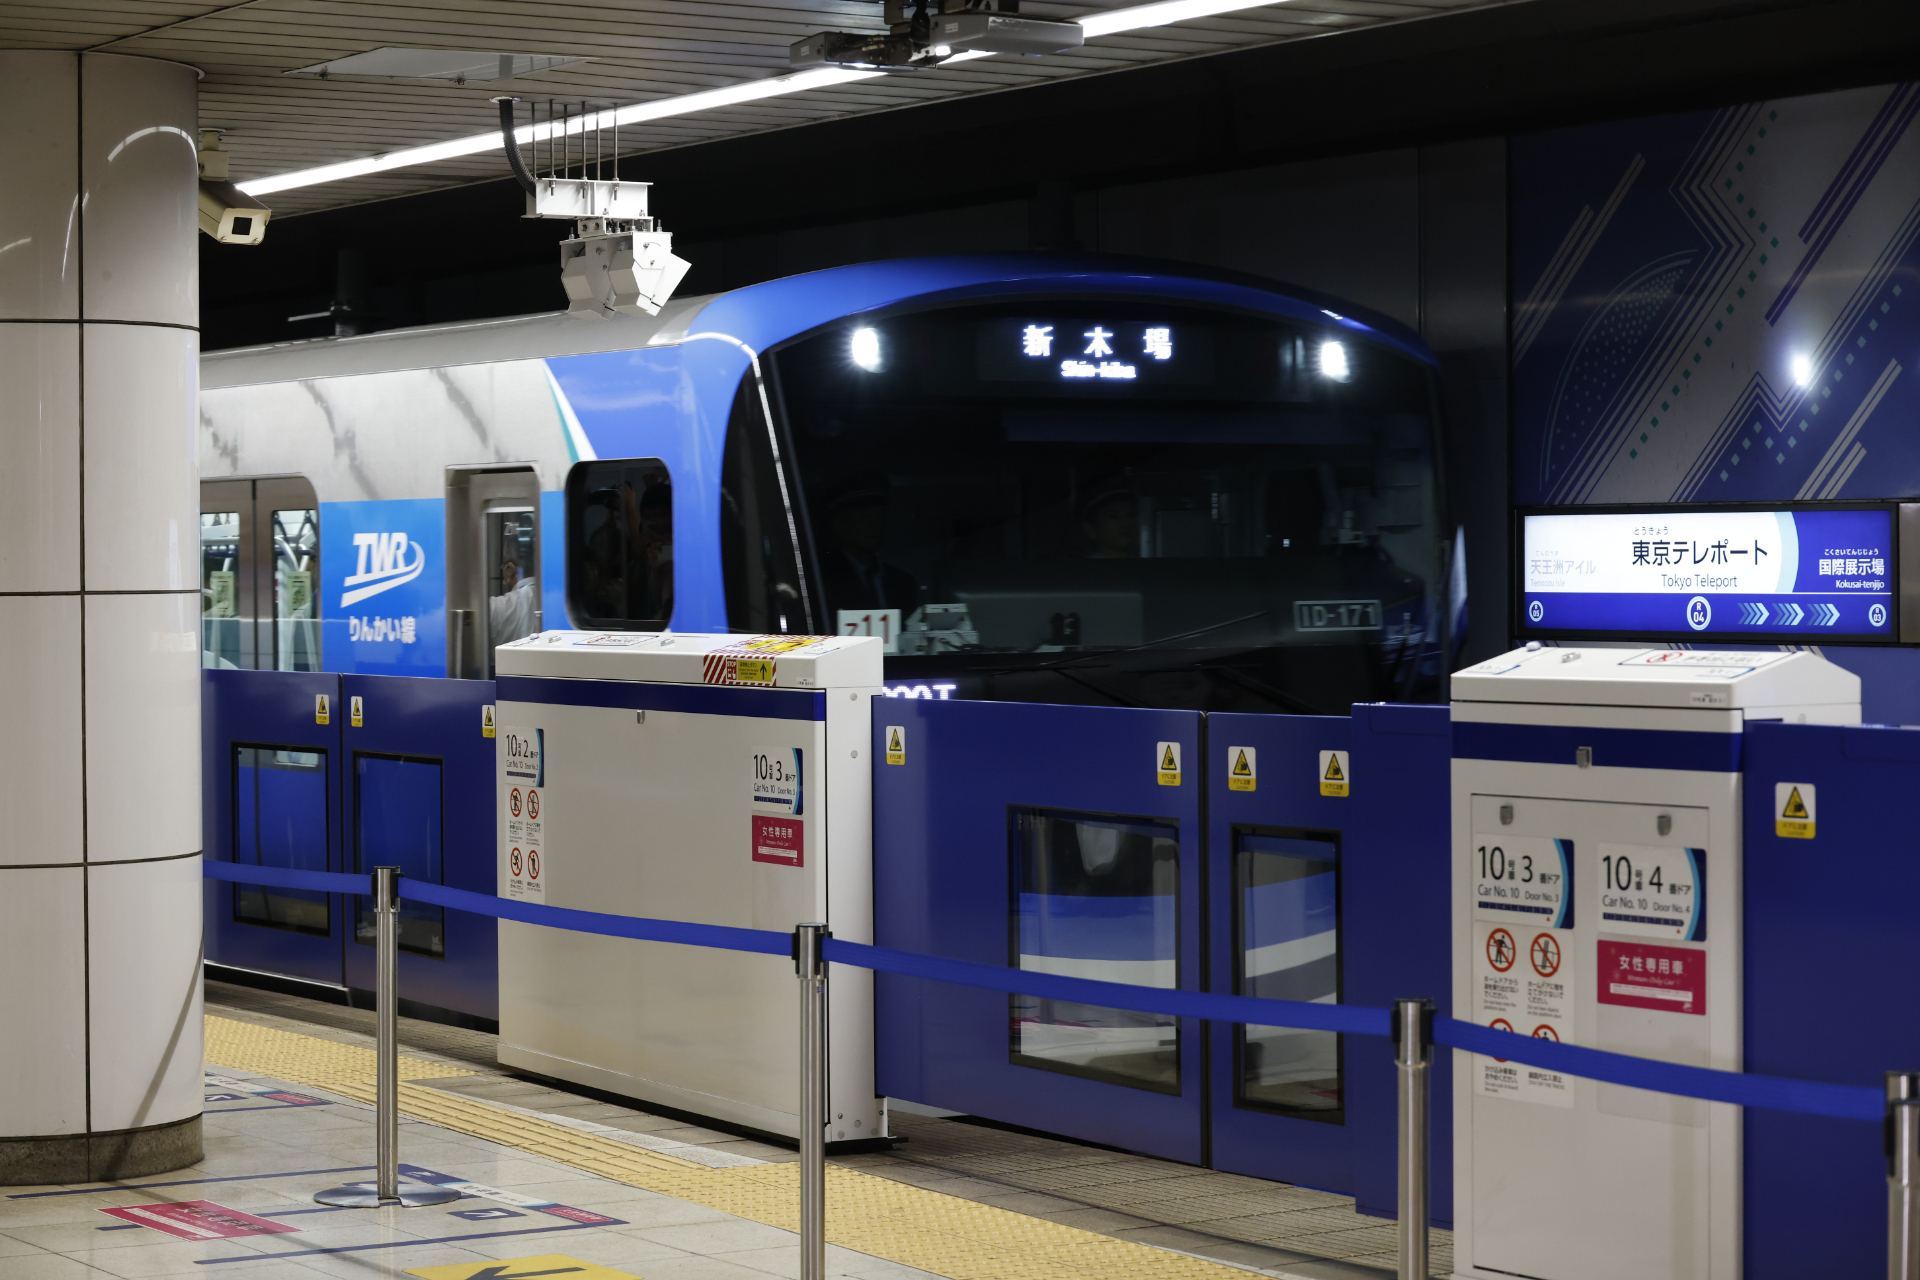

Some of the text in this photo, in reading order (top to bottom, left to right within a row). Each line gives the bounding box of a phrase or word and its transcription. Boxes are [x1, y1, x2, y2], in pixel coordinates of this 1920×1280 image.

[1023, 325, 1172, 359] 新木場
[1634, 526, 1668, 536] とうきょう
[352, 532, 408, 576] TWR
[1632, 538, 1768, 566] 東京テレポート
[1824, 548, 1879, 556] こくさいてんじじょう
[1530, 559, 1597, 575] 天王洲アイル
[1819, 558, 1885, 575] 国際展示場
[1530, 579, 1565, 587] Tennozu Isle
[1661, 574, 1737, 590] Tokyo Teleport
[1835, 579, 1885, 591] Kokusai-tenjijo
[1532, 610, 1540, 618] 05
[1696, 603, 1702, 611] R
[1301, 604, 1377, 627] ID-171
[1693, 612, 1705, 622] 04
[349, 615, 417, 644] りんかい線
[770, 784, 776, 794] 10
[762, 825, 793, 839] 女性専用車
[1478, 884, 1492, 896] Car
[1494, 886, 1508, 898] No.
[1510, 887, 1520, 899] 10
[1525, 891, 1541, 901] Door
[1555, 893, 1559, 903] 3
[1602, 895, 1617, 907] Car
[1620, 896, 1635, 909] No.
[1637, 898, 1648, 910] 10
[1653, 902, 1670, 912] Door
[1685, 905, 1691, 913] 4
[1619, 954, 1684, 976] 女性専用車
